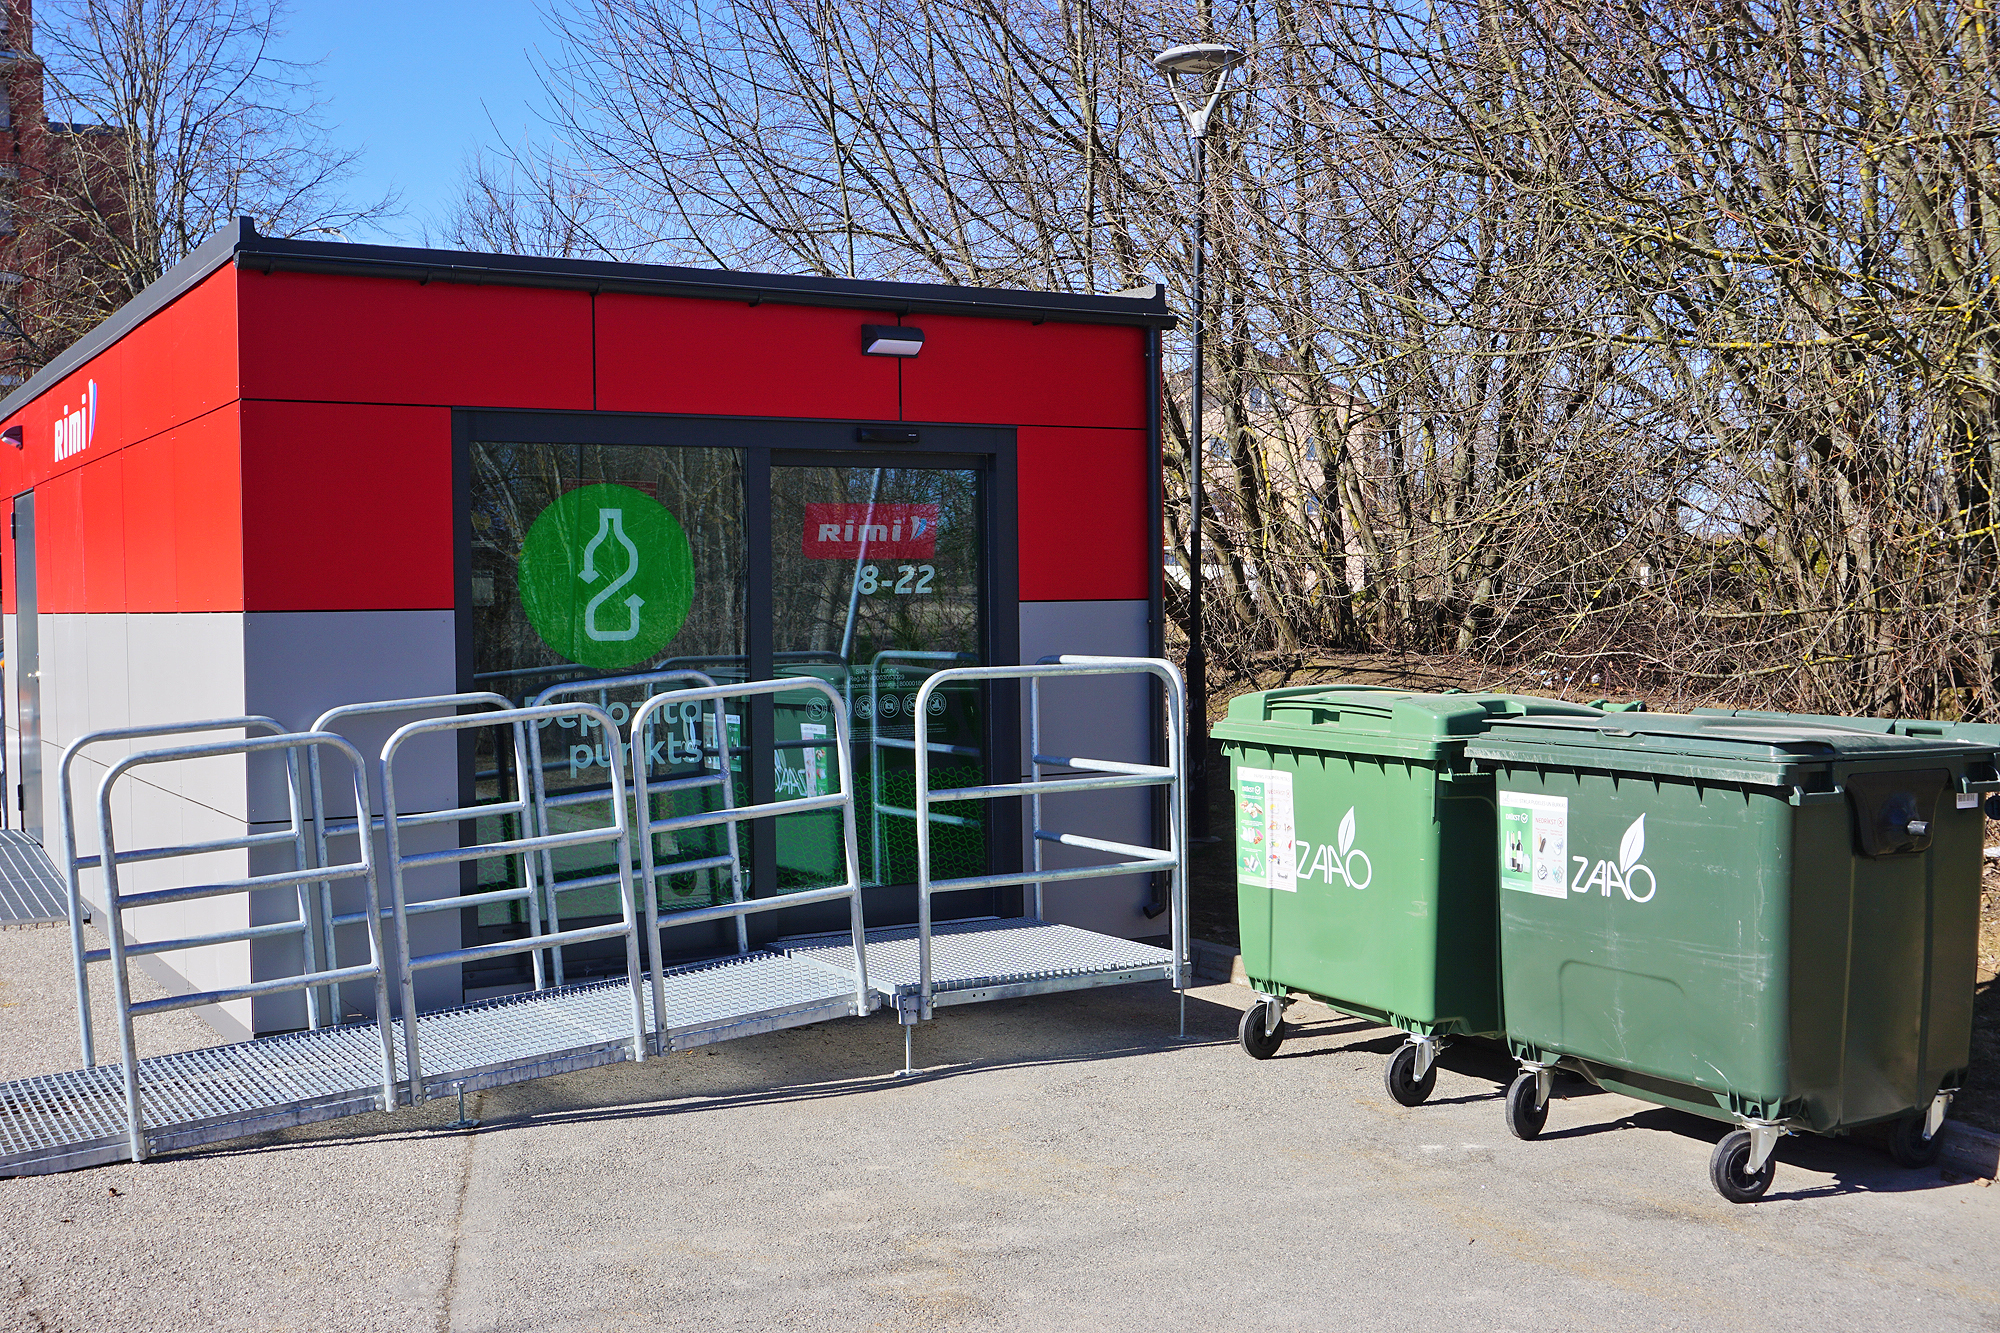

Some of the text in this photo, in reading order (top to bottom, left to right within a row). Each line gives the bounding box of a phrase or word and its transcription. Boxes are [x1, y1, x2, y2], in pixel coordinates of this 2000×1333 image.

[54, 393, 87, 463] Rimi
[817, 519, 902, 542] Rimi
[857, 564, 935, 595] 8-22
[1296, 840, 1372, 890] ZAAO
[1571, 855, 1657, 903] ZAAO
